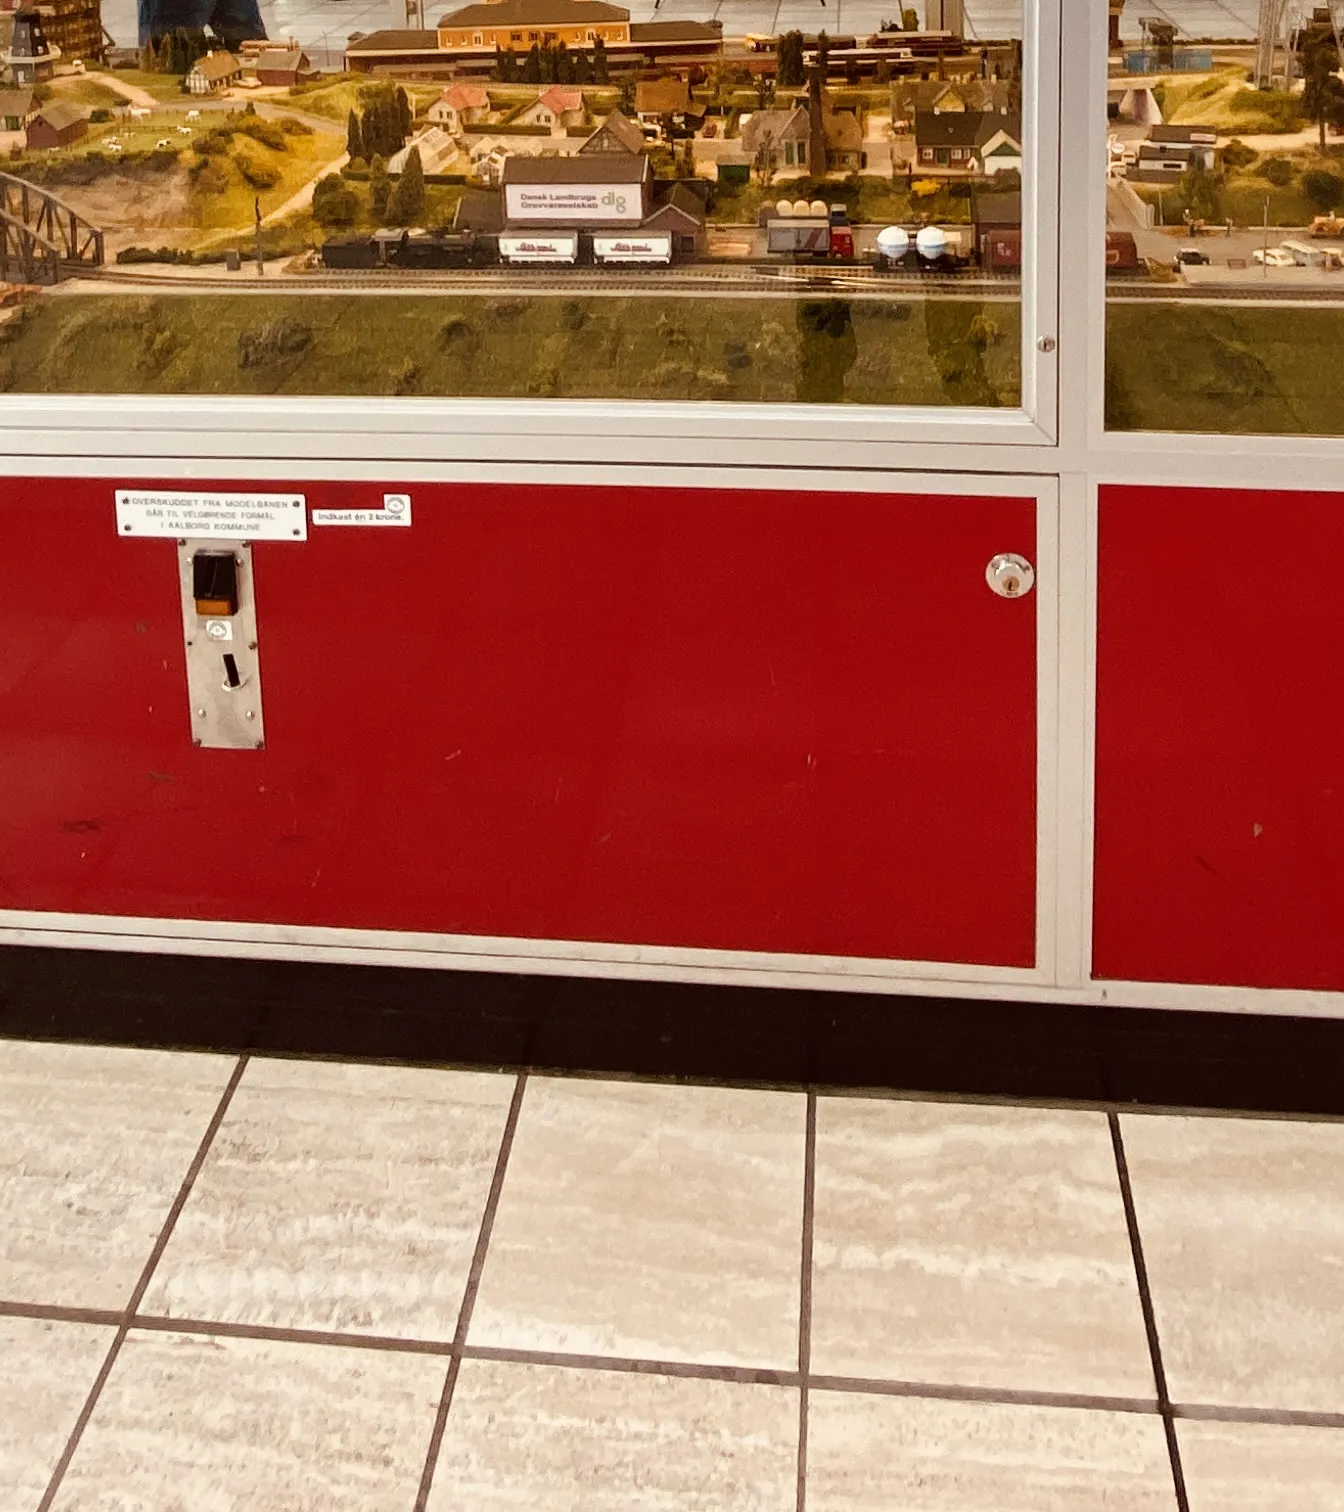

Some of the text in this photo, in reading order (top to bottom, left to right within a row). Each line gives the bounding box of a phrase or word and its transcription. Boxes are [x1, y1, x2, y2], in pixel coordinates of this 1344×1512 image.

[520, 193, 547, 201] Dansk
[132, 497, 288, 508] OVERSKUDDET FRA MODELBANEN
[167, 510, 179, 518] TIL
[182, 510, 237, 519] VELGØRENDE
[241, 510, 275, 520] FORMÅL
[368, 513, 374, 521] 2
[168, 522, 210, 530] AALBORG
[214, 523, 261, 531] KOMMUNE
